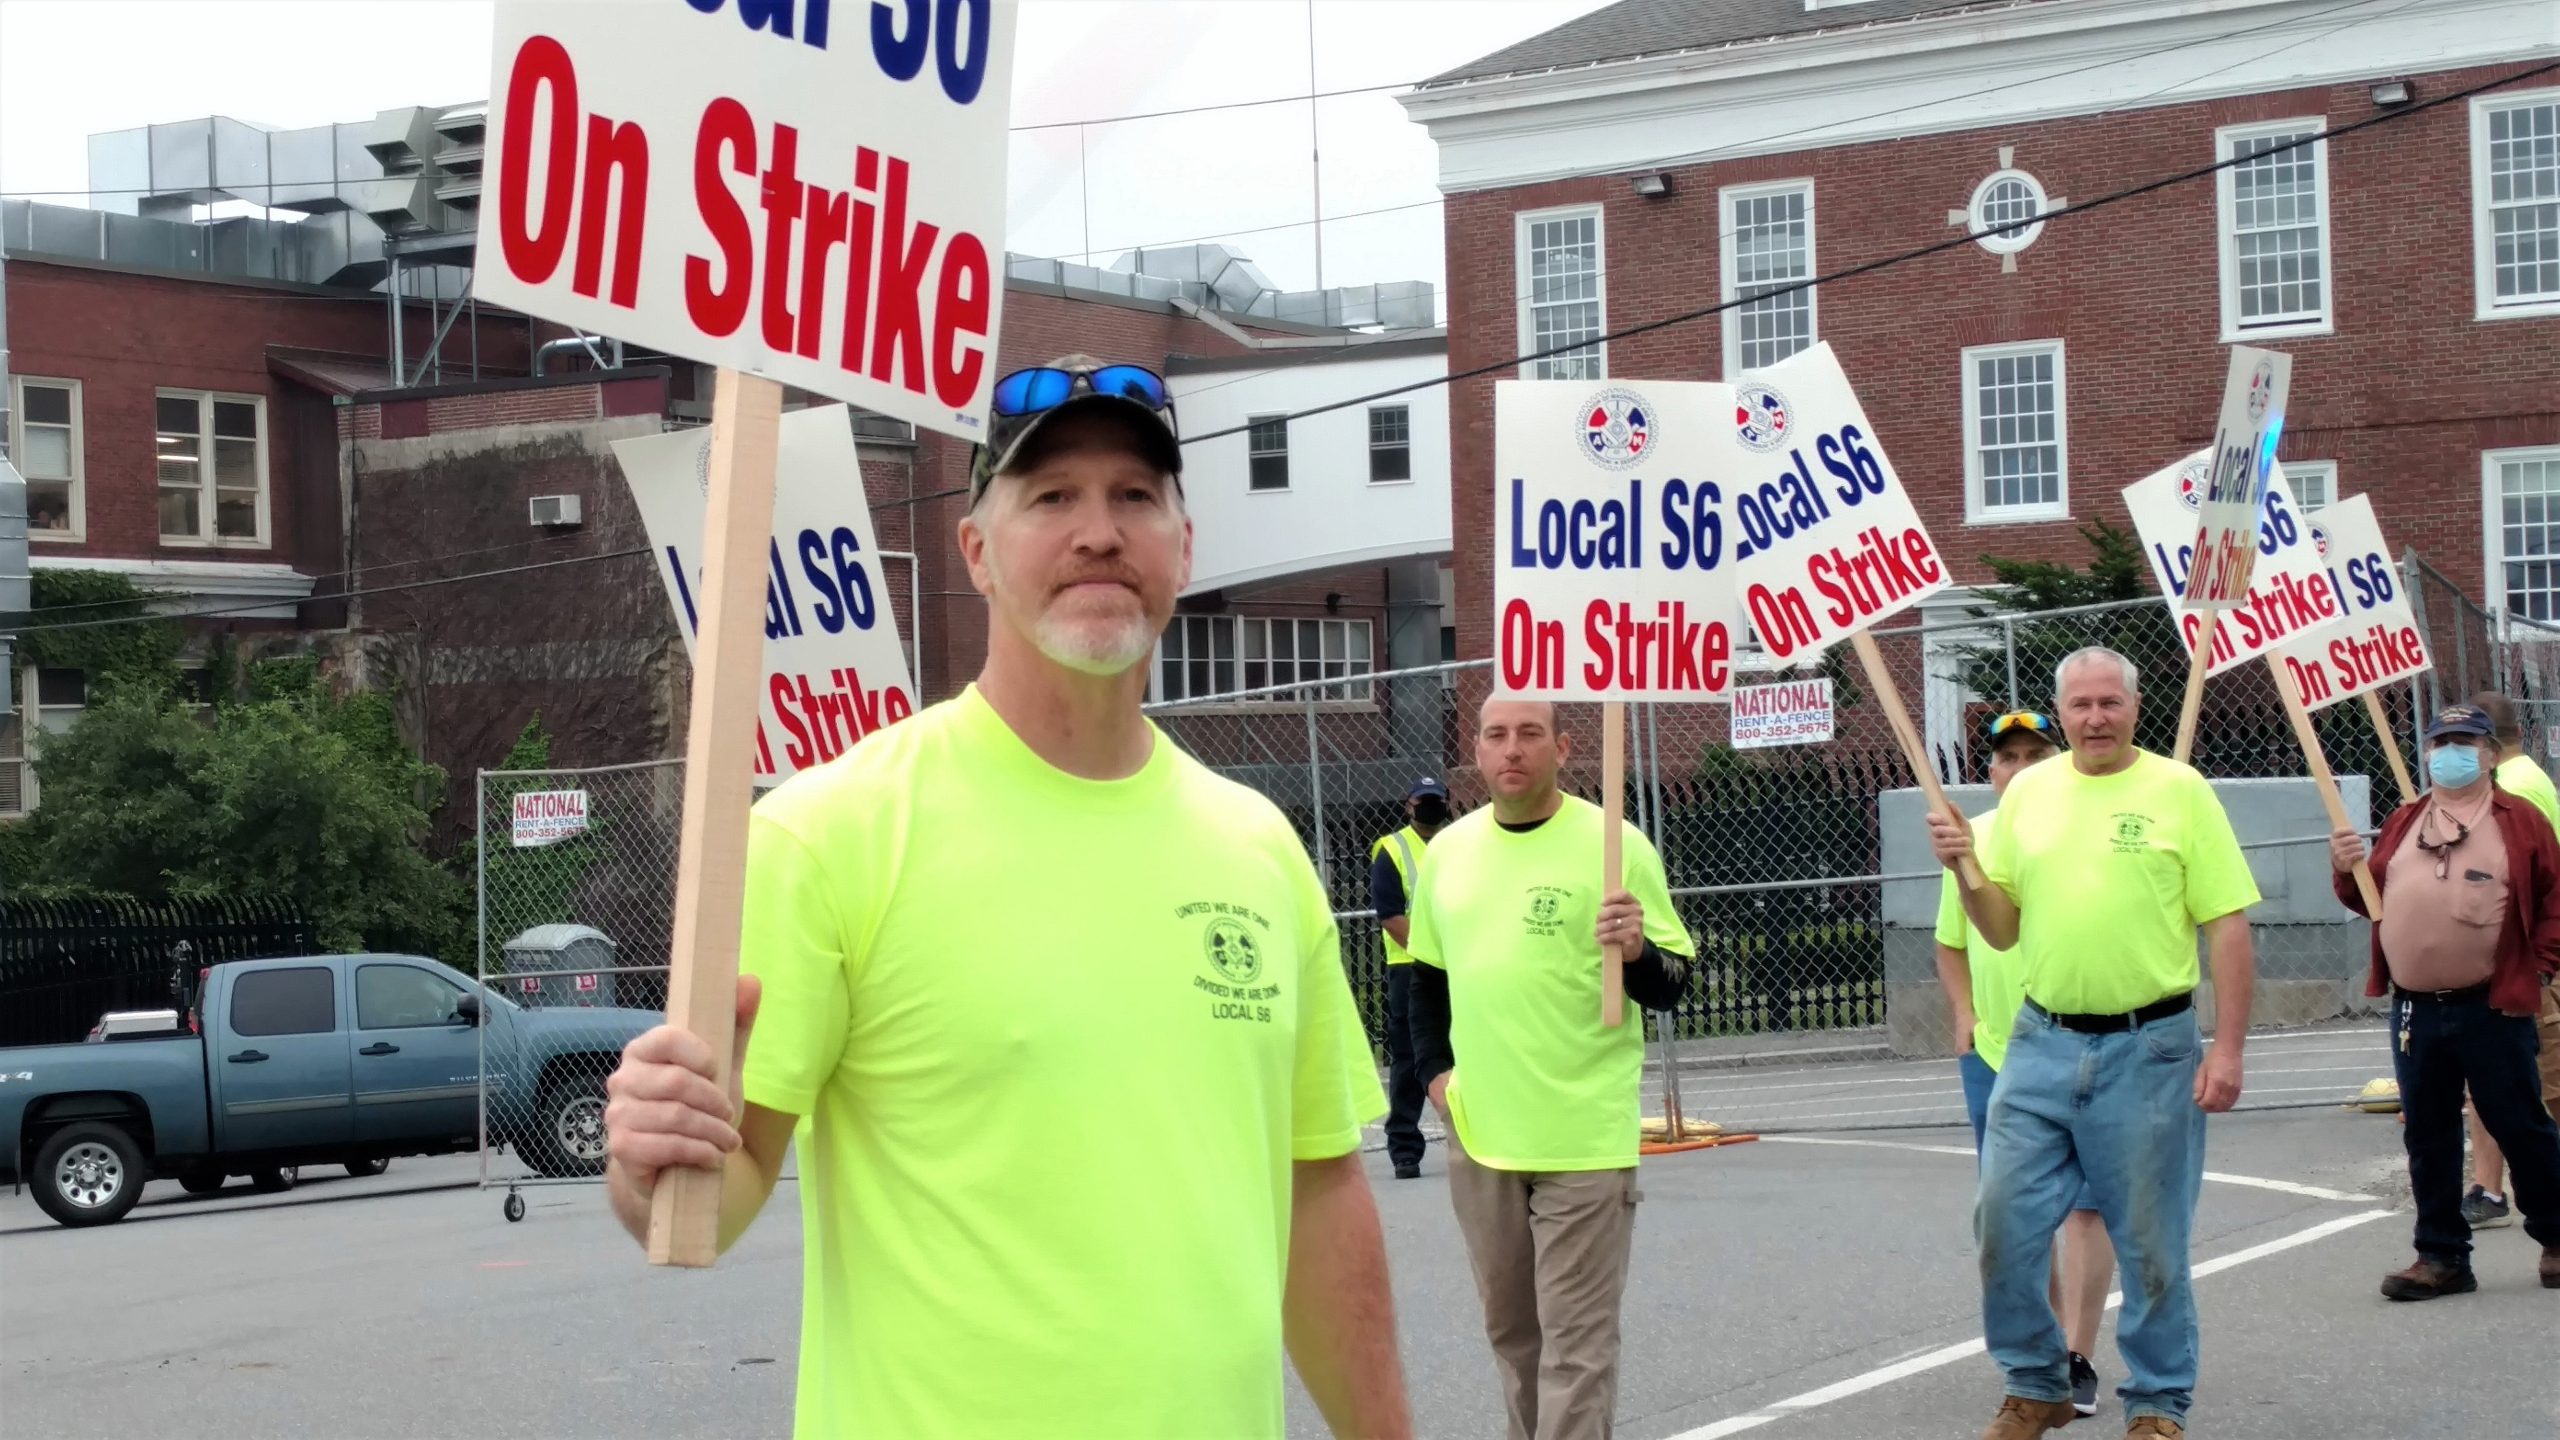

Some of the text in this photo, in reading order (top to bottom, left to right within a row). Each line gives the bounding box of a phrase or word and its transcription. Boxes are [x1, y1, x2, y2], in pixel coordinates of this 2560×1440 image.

[499, 35, 991, 408] On Strike
[1816, 424, 1885, 507] S6
[2208, 428, 2259, 504] Local
[1511, 478, 1722, 571] Local S6
[798, 526, 876, 634] S6
[1748, 526, 1941, 658] On Strike
[2187, 526, 2213, 601] On
[2347, 552, 2393, 610] S6
[2232, 571, 2335, 650] Strike
[1501, 598, 1729, 692] On Strike
[2328, 624, 2424, 691] Strike
[1735, 682, 1830, 717] NATIONAL
[1735, 710, 1831, 728] RENT-A-FENCE
[1735, 722, 1831, 740] 800-352-5675
[515, 793, 584, 819] NATIONAL
[515, 817, 585, 828] RENT-A-FENCE
[1174, 901, 1212, 919] UNITED
[1212, 902, 1230, 914] WE
[1232, 905, 1252, 920] ARE
[1193, 975, 1230, 998] DIVIDED
[1231, 986, 1246, 1000] WE
[1247, 988, 1263, 1000] ARE
[1211, 1002, 1272, 1023] LOCAL S6
